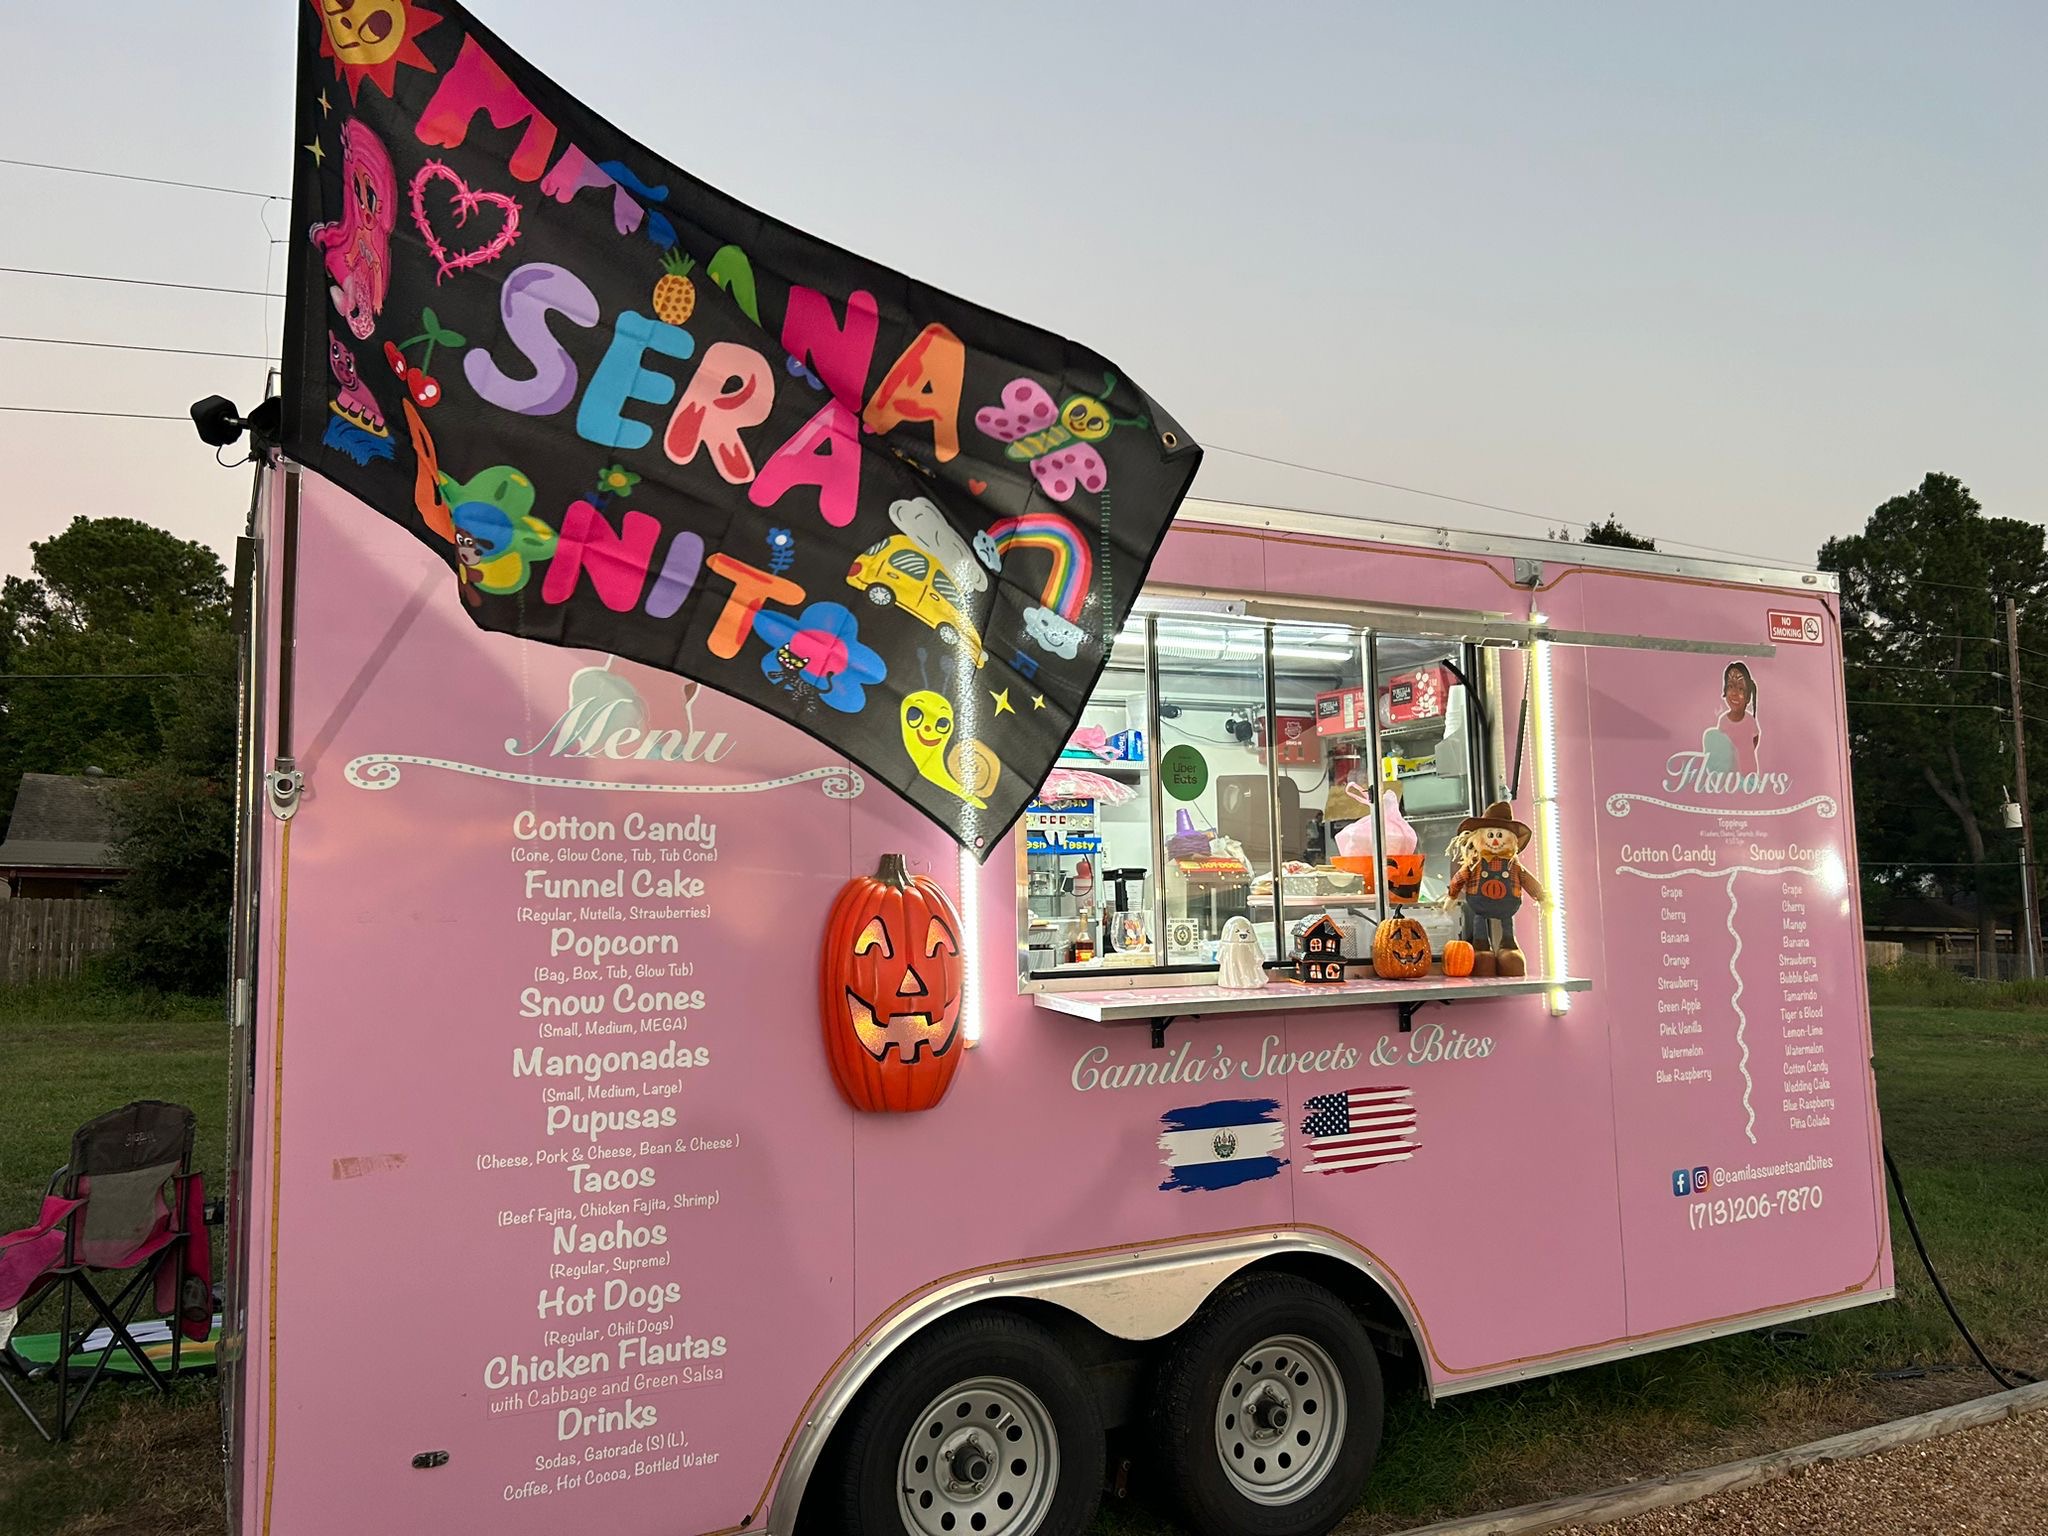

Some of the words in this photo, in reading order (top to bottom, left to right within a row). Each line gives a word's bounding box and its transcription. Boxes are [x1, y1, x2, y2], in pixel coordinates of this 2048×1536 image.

[463, 262, 864, 528] SERA
[1780, 616, 1792, 626] NO
[1773, 627, 1802, 638] SMOKING
[505, 696, 737, 763] Menu
[1172, 762, 1197, 773] Uber
[1662, 751, 1793, 795] Flavors
[1174, 773, 1198, 785] Eats
[513, 810, 615, 840] Cotton
[624, 812, 716, 849] Candy
[511, 847, 553, 863] (Cone,
[557, 848, 588, 861] Glow
[591, 848, 627, 863] Cone,
[631, 848, 656, 863] Tub,
[660, 848, 679, 861] Tub
[683, 848, 717, 861] Cone)
[1621, 844, 1668, 862] Cotton
[1672, 844, 1716, 866] Candy
[1750, 843, 1785, 861] Snow
[525, 869, 624, 898] Funnel
[632, 869, 704, 898] Cake
[1661, 885, 1683, 901] Grape
[1782, 883, 1802, 897] Grape
[517, 907, 576, 925] (Regular,
[580, 906, 626, 921] Nutella,
[630, 904, 710, 919] Strawberries)
[1661, 908, 1686, 923] Cherry
[1782, 900, 1804, 915] Cherry
[1783, 918, 1806, 932] Mango
[551, 928, 678, 965] Popcorn
[1661, 931, 1689, 943] Banana
[1783, 936, 1809, 947] Banana
[1663, 954, 1690, 968] Orange
[1779, 953, 1816, 967] Strawberry
[535, 967, 569, 984] (Bag,
[573, 966, 602, 980] Box,
[606, 965, 632, 980] Tub,
[635, 964, 665, 977] Glow
[668, 962, 693, 976] Tub)
[1780, 971, 1802, 984] Bubble
[1804, 971, 1818, 982] Gum
[1658, 976, 1698, 991] Strawberry
[519, 987, 605, 1017] Snow
[613, 983, 705, 1013] Cones
[1783, 989, 1817, 1002] Tamarindo
[1658, 1000, 1680, 1013] Green
[1681, 998, 1701, 1014] Apple
[1780, 1008, 1803, 1023] Tiger's
[1804, 1006, 1823, 1018] Blood
[539, 1022, 582, 1038] (Small,
[586, 1021, 637, 1035] Medium,
[640, 1016, 687, 1032] MEGA)
[1660, 1023, 1677, 1036] Pink
[1678, 1021, 1702, 1034] Vanilla
[1783, 1025, 1823, 1038] Lemon-Lime
[1071, 1039, 1236, 1091] Camila's
[1240, 1034, 1362, 1080] Sweets
[1369, 1036, 1400, 1067] &
[1407, 1023, 1497, 1065] Bites
[1662, 1044, 1703, 1059] Watermelon
[1785, 1042, 1824, 1056] Watermelon
[513, 1040, 710, 1081] Mangonadas
[1784, 1062, 1806, 1075] Cotton
[1807, 1060, 1828, 1074] Candy
[1657, 1070, 1672, 1083] Blue
[1674, 1067, 1712, 1084] Raspberry
[543, 1086, 584, 1103] (Small,
[588, 1084, 639, 1099] Medium,
[643, 1079, 682, 1098] Large)
[1784, 1080, 1812, 1094] Wedding
[1814, 1077, 1830, 1090] Cake
[1783, 1099, 1798, 1111] Blue
[1799, 1096, 1834, 1112] Raspberry
[547, 1105, 676, 1142] Pupusas
[1807, 1114, 1830, 1127] Colada
[477, 1154, 532, 1170] (Cheese,
[536, 1149, 568, 1164] Pork
[571, 1147, 584, 1161] &
[588, 1146, 636, 1159] Cheese,
[640, 1142, 672, 1155] Bean
[675, 1139, 686, 1152] &
[690, 1137, 732, 1151] Cheese
[567, 1164, 656, 1193] Tacos
[1714, 1156, 1832, 1185] @camilassweetsandbites
[498, 1209, 535, 1227] (Beef
[538, 1208, 576, 1225] Fajita,
[580, 1200, 629, 1217] Chicken
[633, 1198, 670, 1216] Fajita,
[674, 1190, 719, 1209] Shrimp)
[1690, 1187, 1822, 1229] (713)206-7870
[553, 1219, 667, 1255] Nachos
[550, 1260, 609, 1280] (Regular,
[613, 1251, 670, 1274] Supreme)
[537, 1286, 596, 1319] Hot
[604, 1279, 681, 1313] Dogs
[544, 1327, 604, 1347] (Regular,
[608, 1321, 635, 1337] Chili
[638, 1315, 673, 1335] Dogs)
[484, 1348, 609, 1389] Chicken
[618, 1335, 727, 1369] Flautas
[491, 1393, 523, 1413] with
[528, 1385, 596, 1407] Cabbage
[602, 1376, 629, 1395] and
[634, 1374, 678, 1390] Green
[683, 1365, 722, 1383] Salsa
[558, 1399, 657, 1441] Drinks
[536, 1453, 580, 1470] Sodas,
[585, 1440, 643, 1461] Gatorade
[646, 1434, 664, 1451] (S)
[667, 1431, 688, 1448] (L),
[504, 1481, 552, 1501] Coffee,
[557, 1474, 581, 1491] Hot
[585, 1469, 630, 1485] Cocoa,
[635, 1458, 679, 1476] Bottled
[683, 1453, 719, 1467] Water
